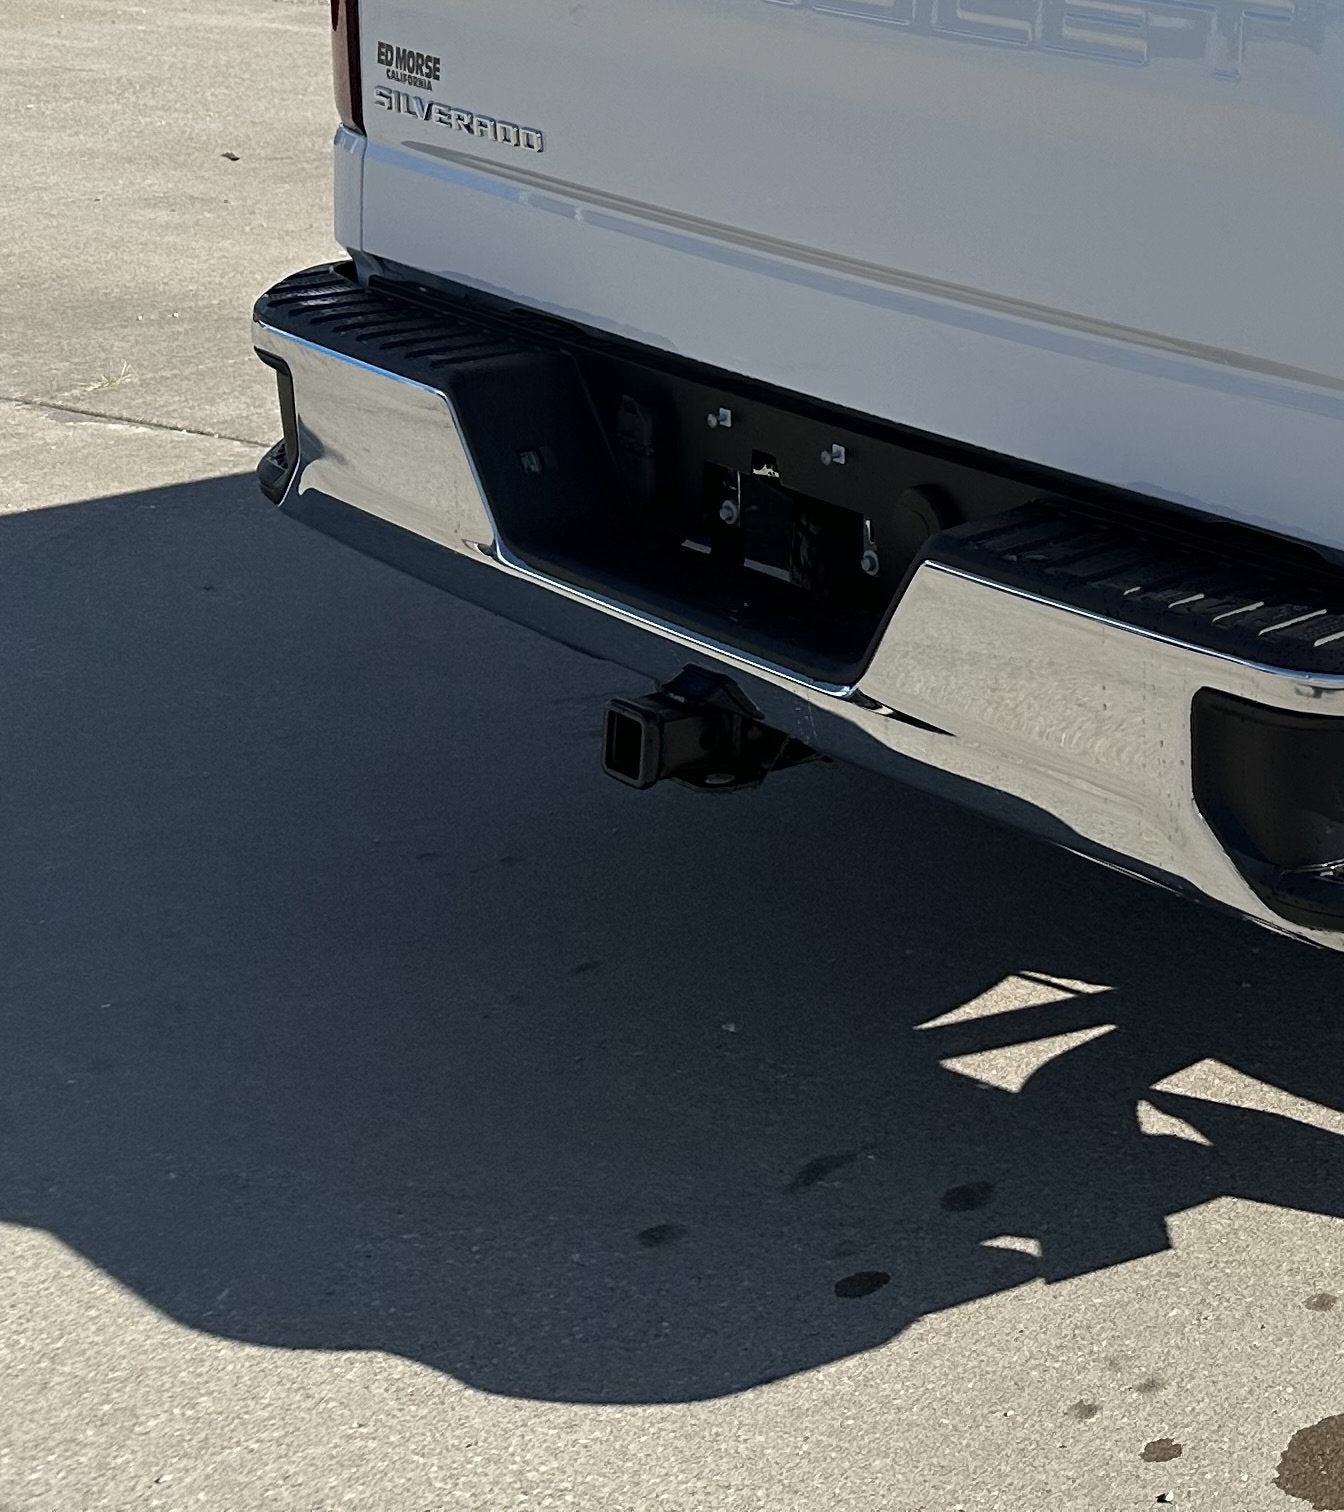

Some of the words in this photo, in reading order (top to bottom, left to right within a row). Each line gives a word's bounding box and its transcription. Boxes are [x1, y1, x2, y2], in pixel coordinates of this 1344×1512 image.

[377, 40, 395, 67] ED
[396, 45, 441, 81] MORSE
[386, 67, 433, 92] CALIFORNIA
[373, 85, 545, 153] SILVERADO
